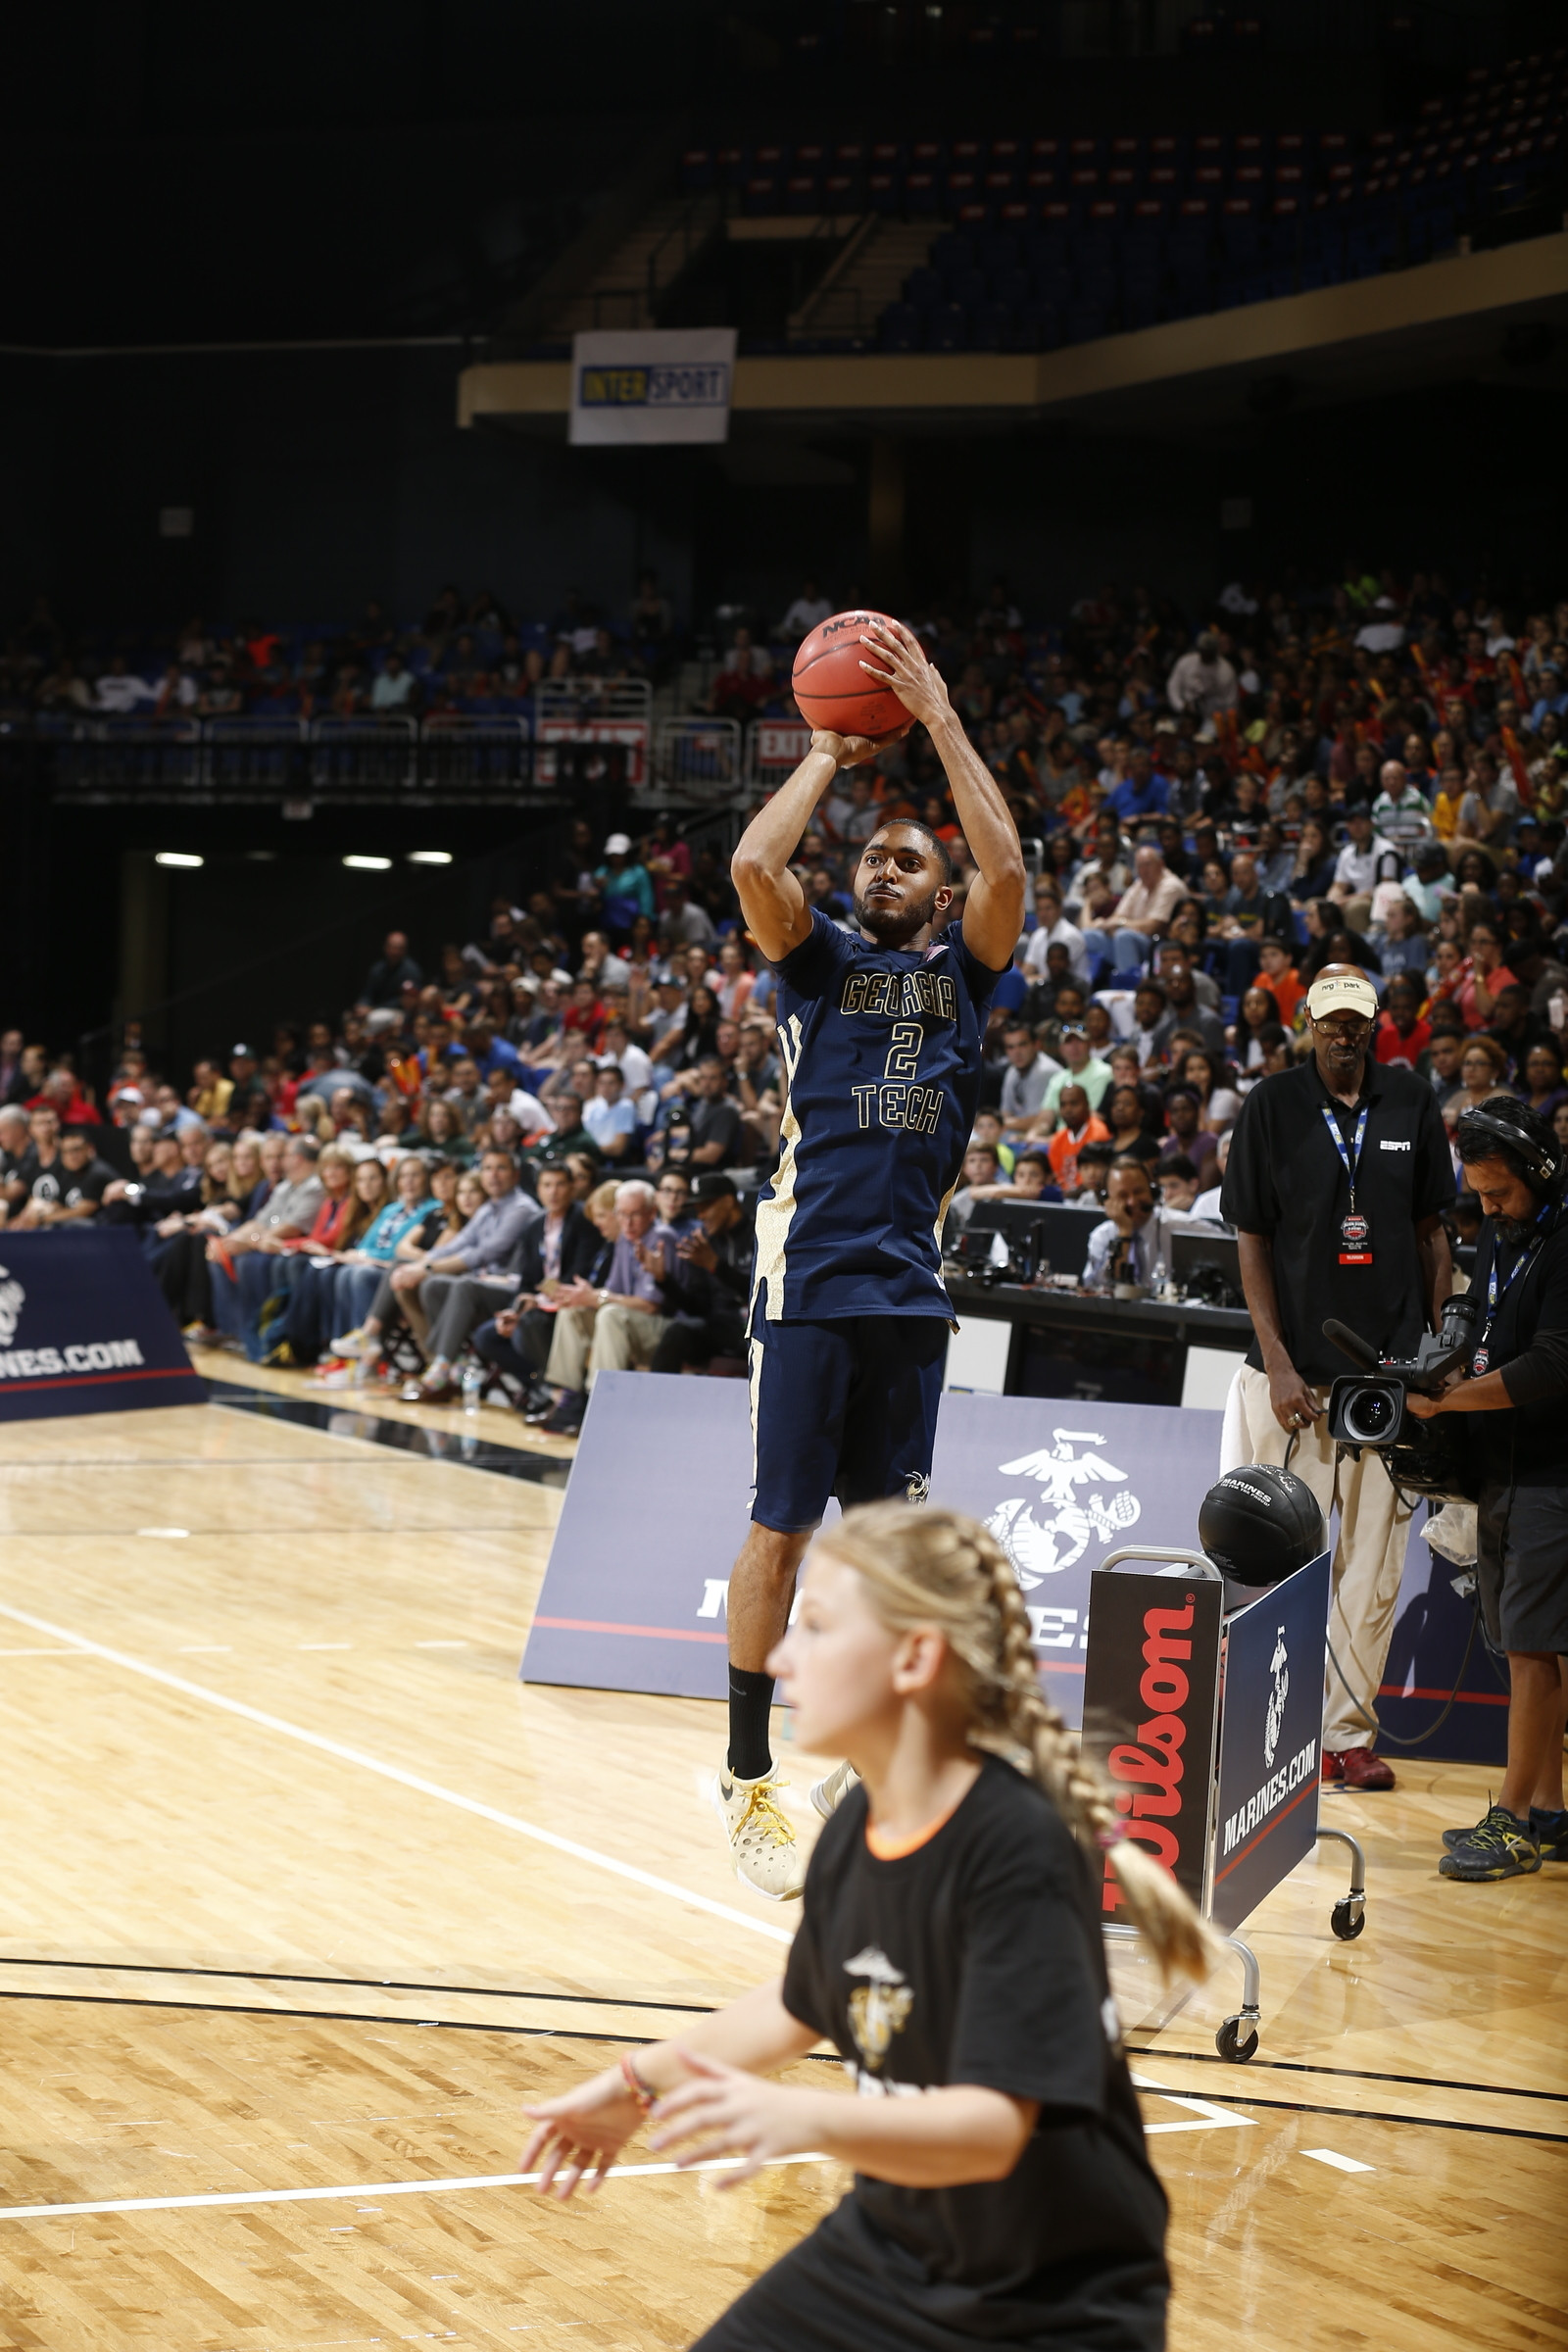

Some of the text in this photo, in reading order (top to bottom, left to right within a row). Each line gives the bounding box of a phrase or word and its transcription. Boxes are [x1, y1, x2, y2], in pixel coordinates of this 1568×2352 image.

[822, 615, 887, 638] NCAA
[840, 970, 957, 1022] GEORGIA
[1321, 983, 1335, 992] nrg
[884, 1022, 924, 1081] 2
[851, 1084, 945, 1135] TECH
[1380, 1140, 1411, 1152] ESPN
[1222, 1478, 1272, 1503] MARINES
[1223, 1738, 1316, 1856] MARINES.COM
